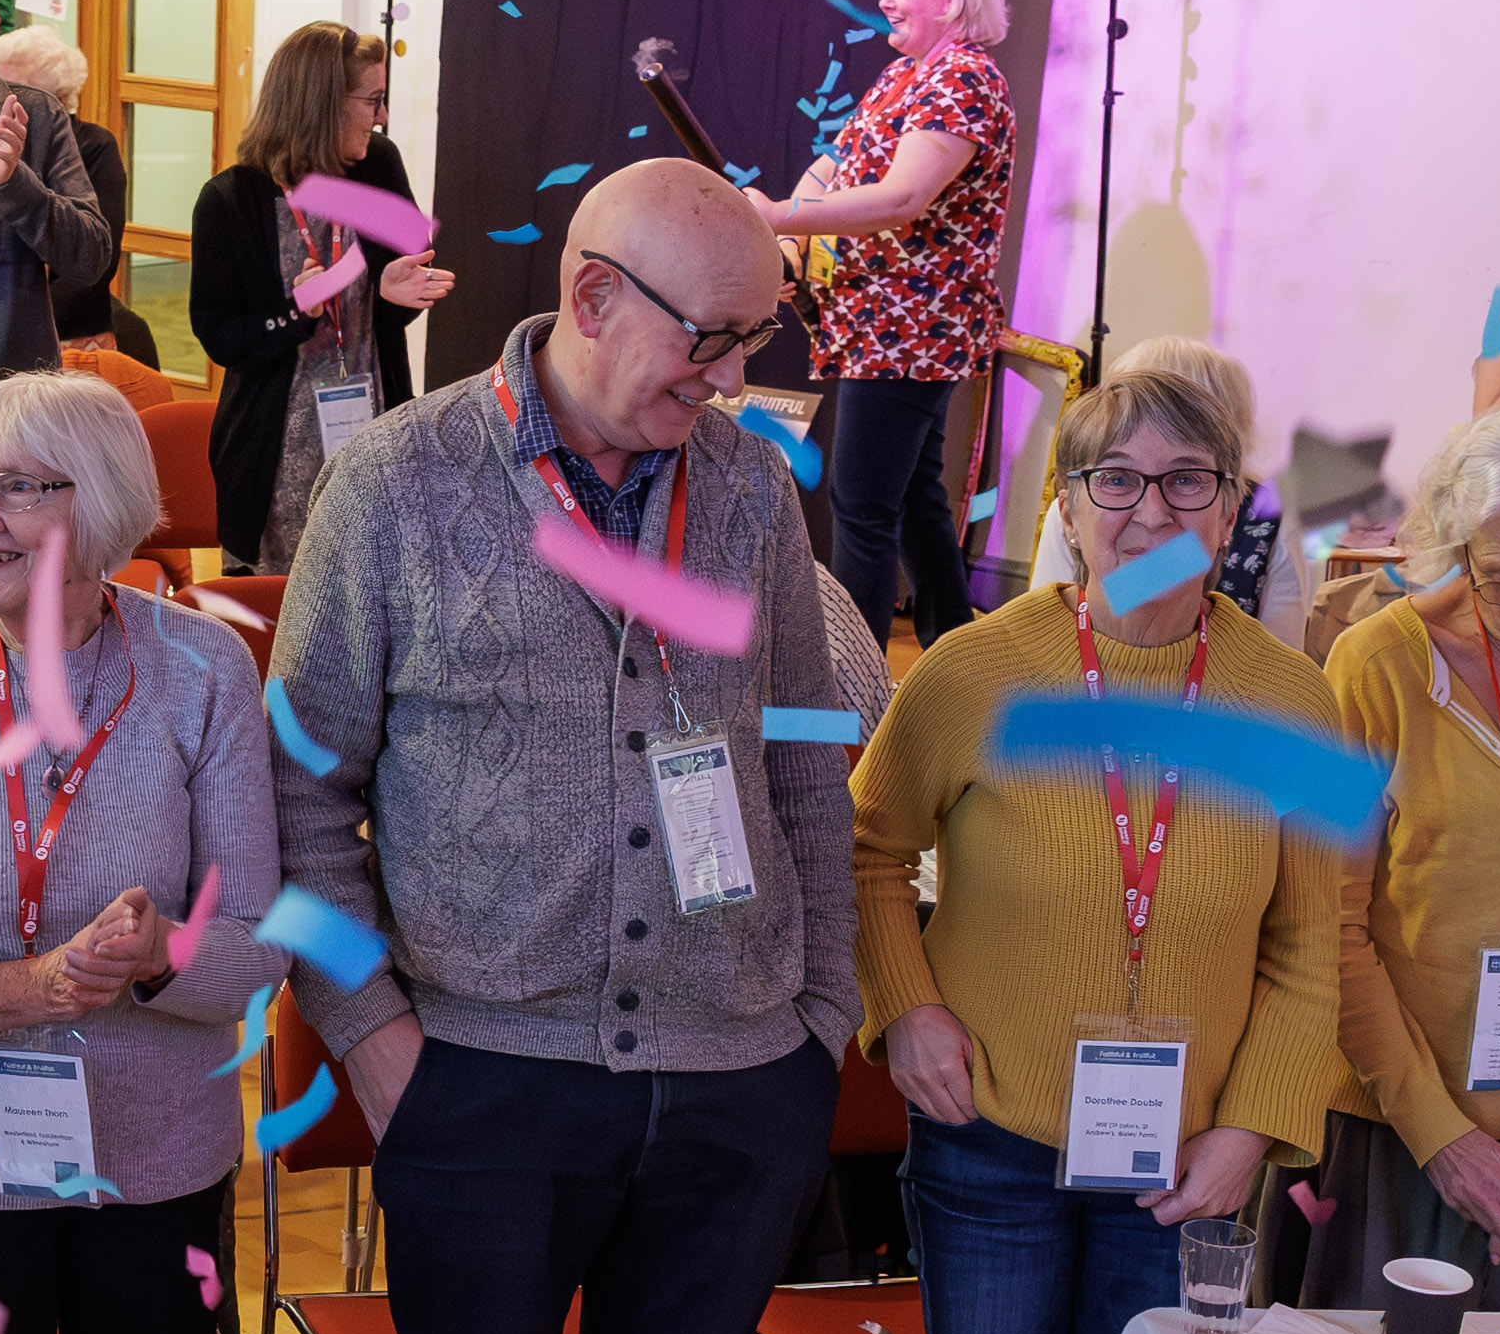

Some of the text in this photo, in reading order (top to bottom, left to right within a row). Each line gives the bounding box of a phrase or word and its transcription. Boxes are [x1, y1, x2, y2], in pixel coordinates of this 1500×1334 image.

[1084, 1096, 1164, 1108] Dorothee Double
[4, 1106, 43, 1117] Maureen
